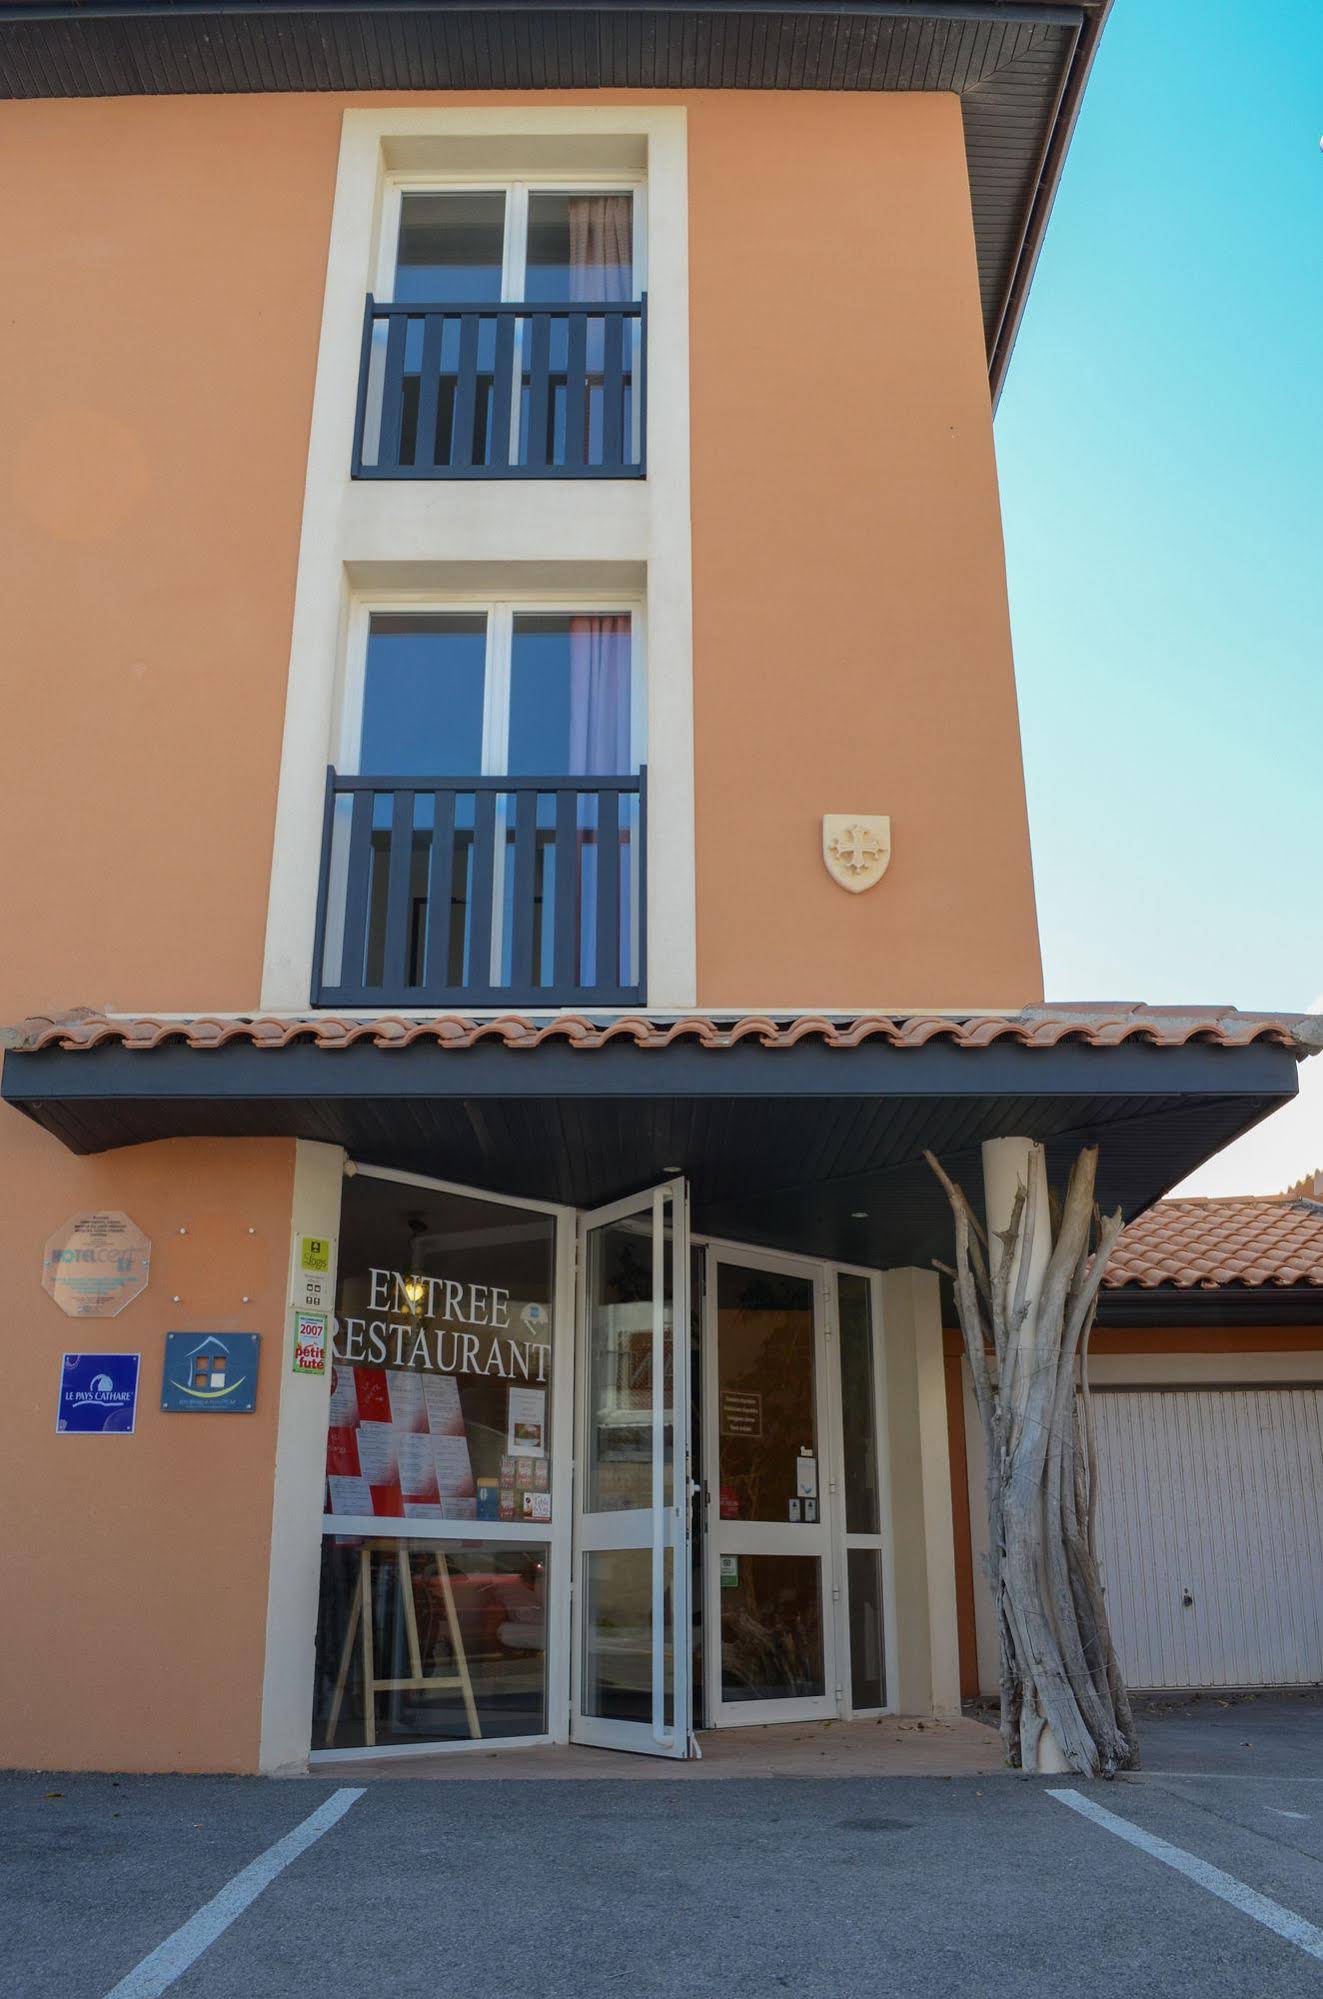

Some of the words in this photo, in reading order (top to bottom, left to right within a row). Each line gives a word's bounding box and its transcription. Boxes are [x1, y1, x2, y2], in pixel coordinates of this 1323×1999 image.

[366, 1268, 511, 1329] ENTREE
[300, 1323, 323, 1337] 2007
[65, 1391, 74, 1401] LE
[75, 1391, 94, 1401] PAYS
[94, 1391, 132, 1401] CATHARE
